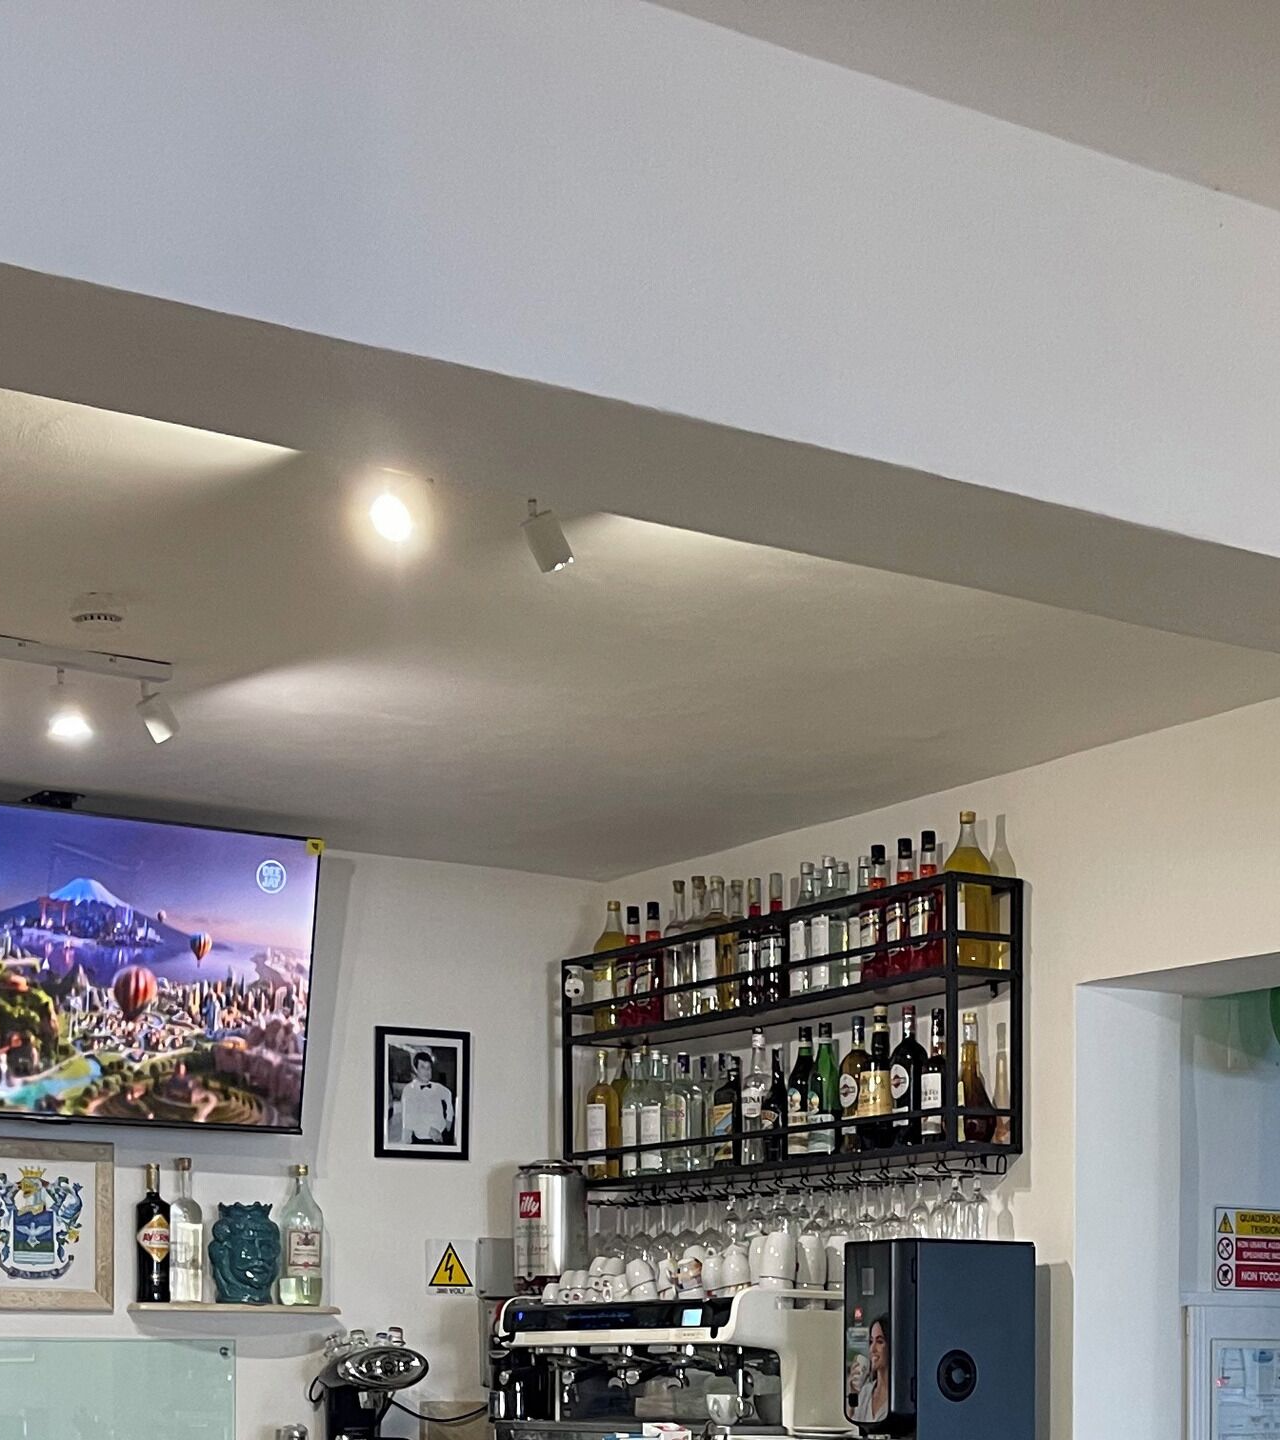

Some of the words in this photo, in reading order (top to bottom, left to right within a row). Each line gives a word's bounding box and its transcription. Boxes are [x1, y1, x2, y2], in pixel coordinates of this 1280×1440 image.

[520, 1196, 540, 1216] illy
[1240, 1214, 1270, 1224] QUADRO
[1241, 1271, 1258, 1281] NON
